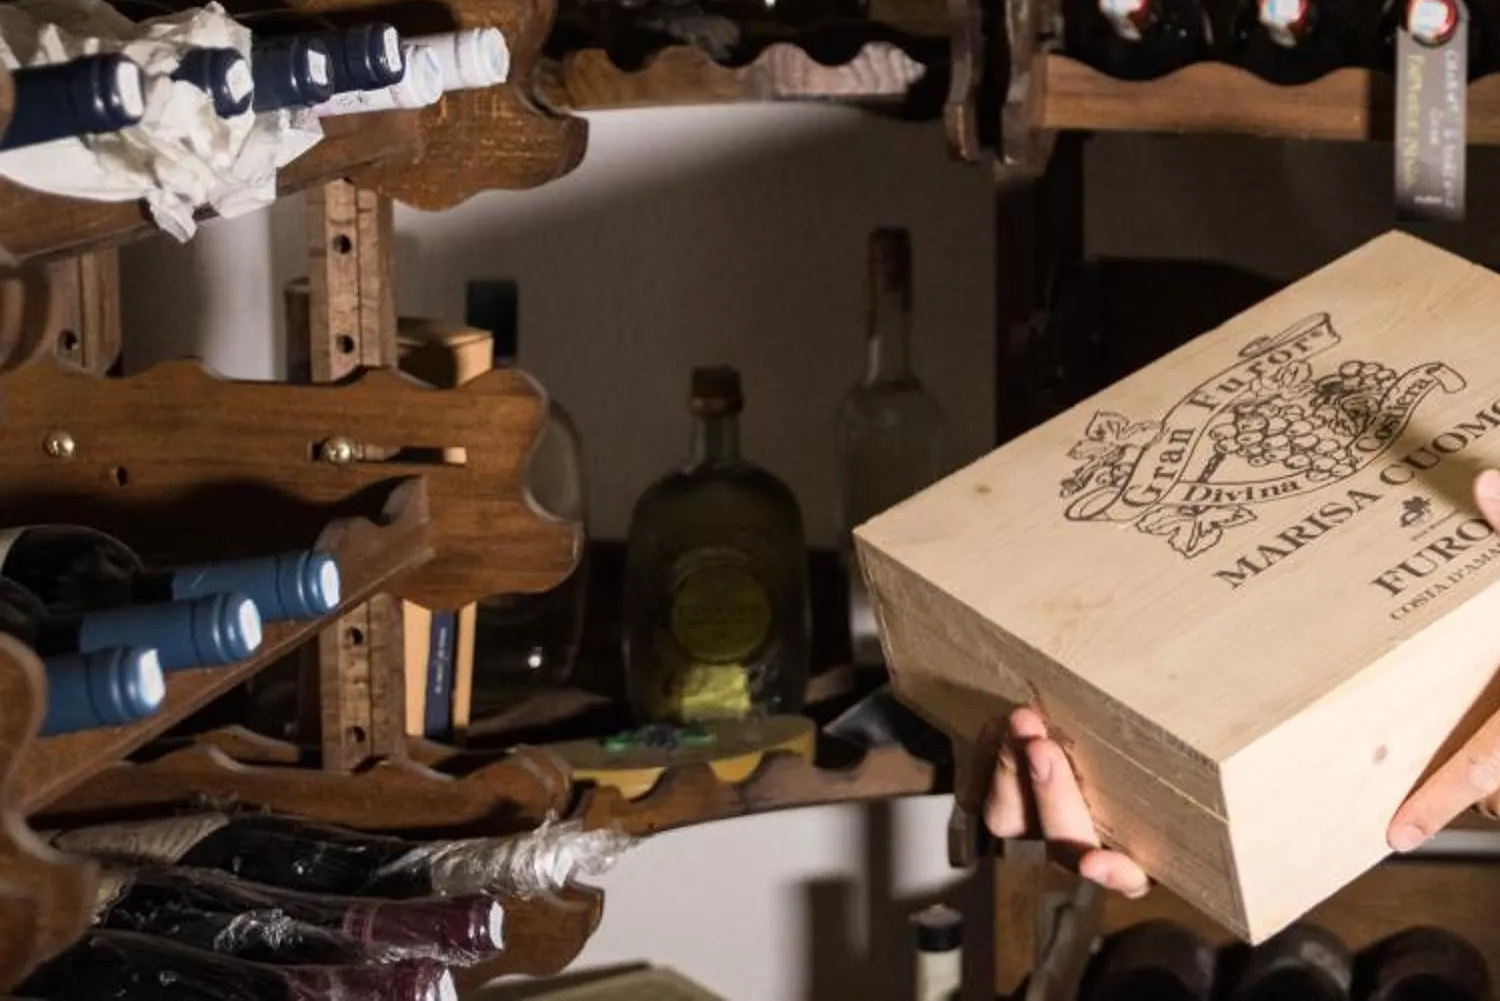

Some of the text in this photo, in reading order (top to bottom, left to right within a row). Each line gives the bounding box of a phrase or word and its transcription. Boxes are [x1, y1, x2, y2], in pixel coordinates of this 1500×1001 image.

[1122, 426, 1196, 506] Gran
[1185, 477, 1301, 503] Divina
[1214, 487, 1384, 590] MARISA
[1372, 517, 1496, 597] FURO
[1389, 580, 1450, 621] COSTA
